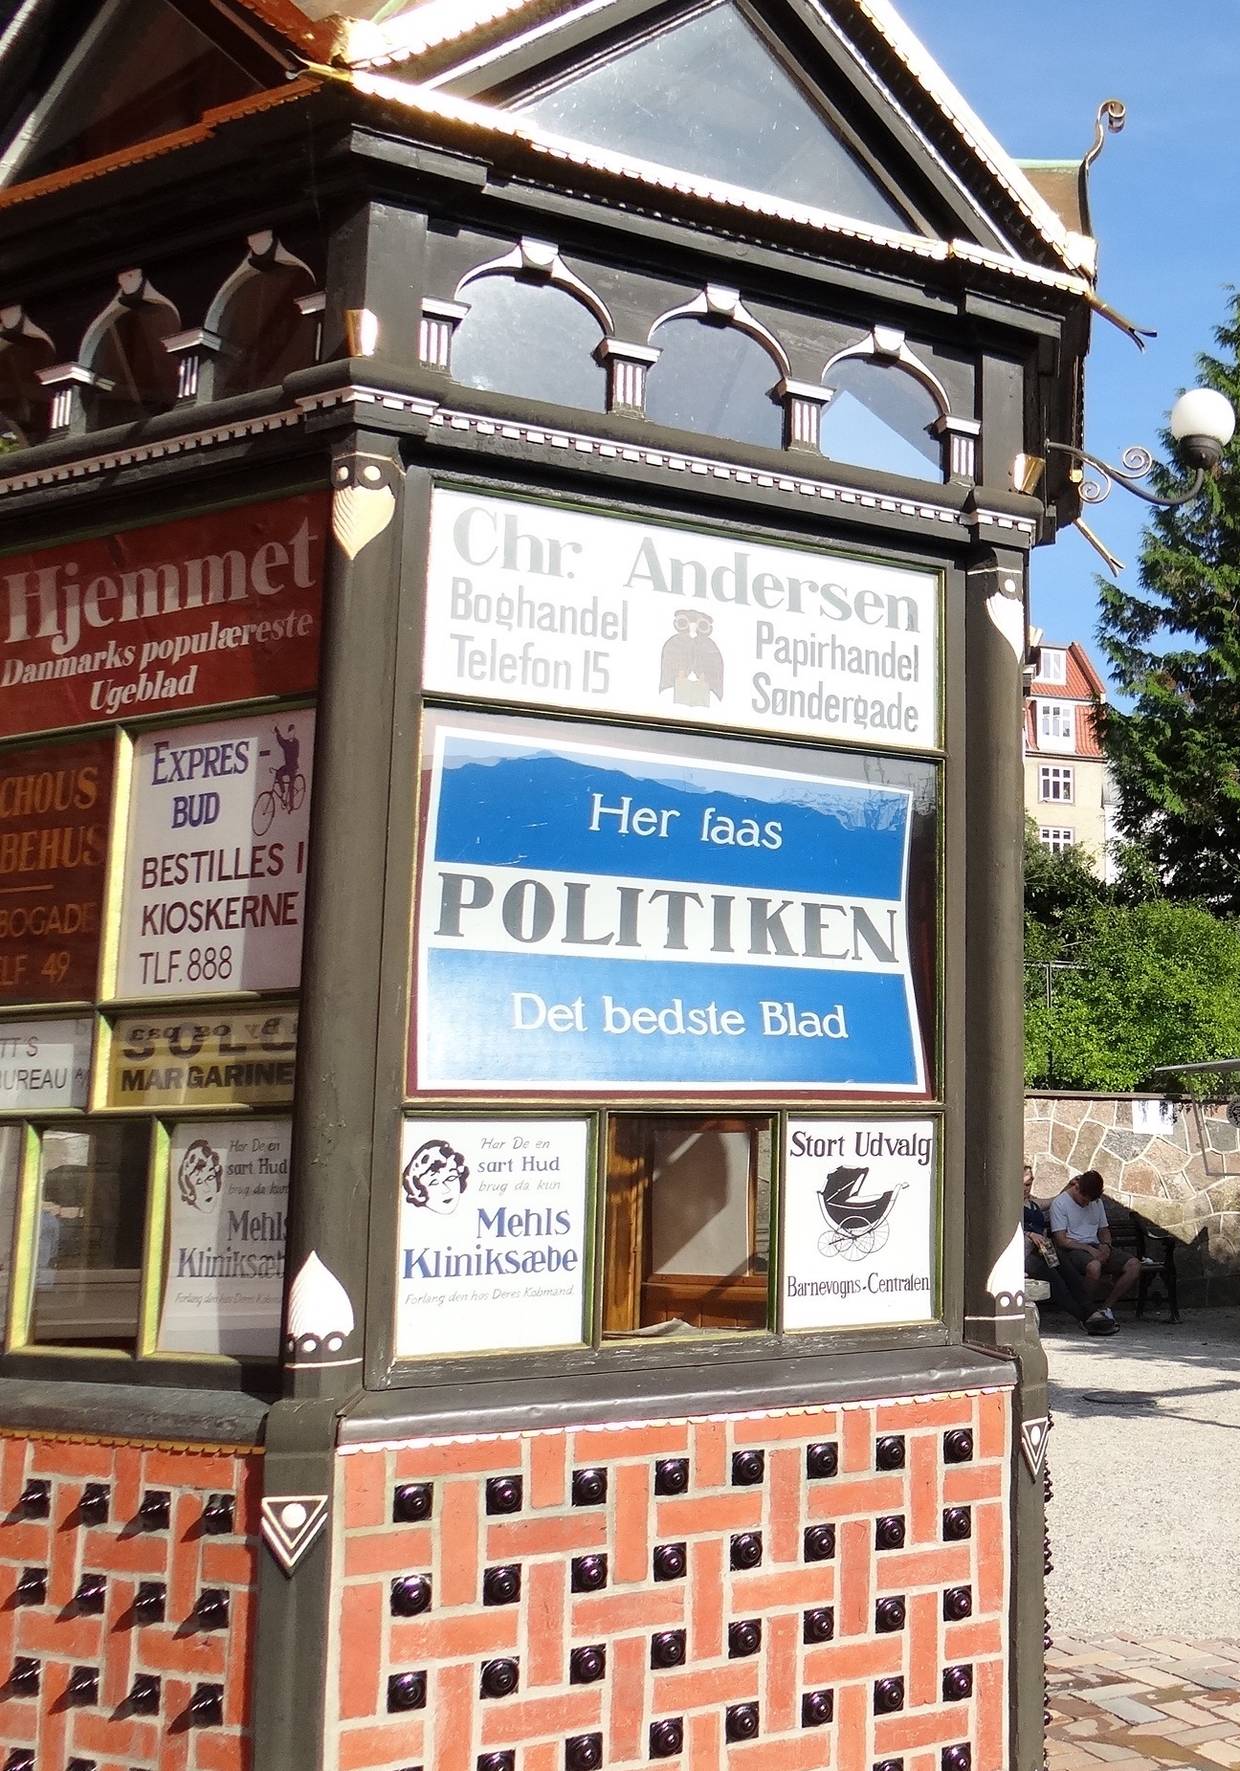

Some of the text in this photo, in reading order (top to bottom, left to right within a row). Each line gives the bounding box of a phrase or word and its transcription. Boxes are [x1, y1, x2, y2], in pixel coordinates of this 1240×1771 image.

[3, 516, 318, 655] Hjemmet
[453, 506, 920, 633] Chr. Andersen
[451, 577, 628, 641] Boghandel
[0, 608, 314, 687] Danmarks populæreste
[449, 634, 611, 694] Telefon 15
[756, 620, 919, 682] Papirhandel
[90, 665, 199, 714] Ugeblad
[752, 672, 919, 733] Søndergade
[171, 792, 221, 829] BUD
[588, 793, 681, 837] Her
[141, 843, 284, 889] BESTILLES
[141, 892, 300, 936] KIOSKERNE
[434, 871, 901, 963] POLITIKEN
[139, 946, 233, 985] TLF. 888
[512, 993, 849, 1039] Det bedste Blad
[0, 1068, 67, 1090] UREAU
[121, 1062, 294, 1092] MARGARINE
[477, 1156, 560, 1173] sart Hud
[480, 1136, 551, 1150] Har De en
[790, 1130, 932, 1165] Stort Udvalg
[226, 1158, 288, 1175] sart Hud
[476, 1206, 572, 1239] Mehls
[177, 1246, 285, 1278] Kliniksæb
[403, 1244, 578, 1279] Kliniksæbe
